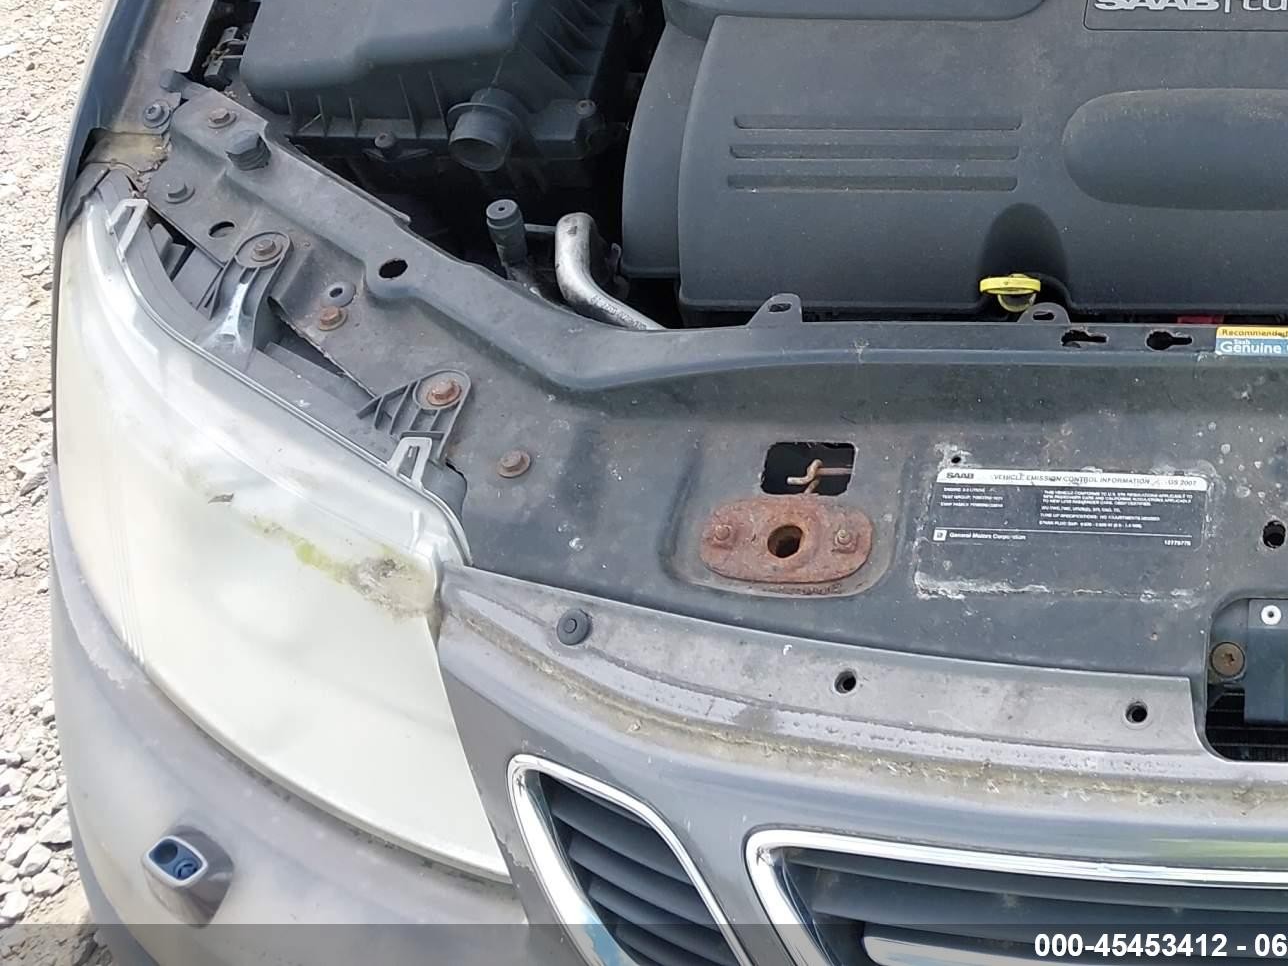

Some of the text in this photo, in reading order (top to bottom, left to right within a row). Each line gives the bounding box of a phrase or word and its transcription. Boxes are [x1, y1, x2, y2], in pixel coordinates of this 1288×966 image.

[1222, 328, 1288, 338] Recommended
[1220, 341, 1281, 355] Genuine
[946, 472, 975, 480] SAAB
